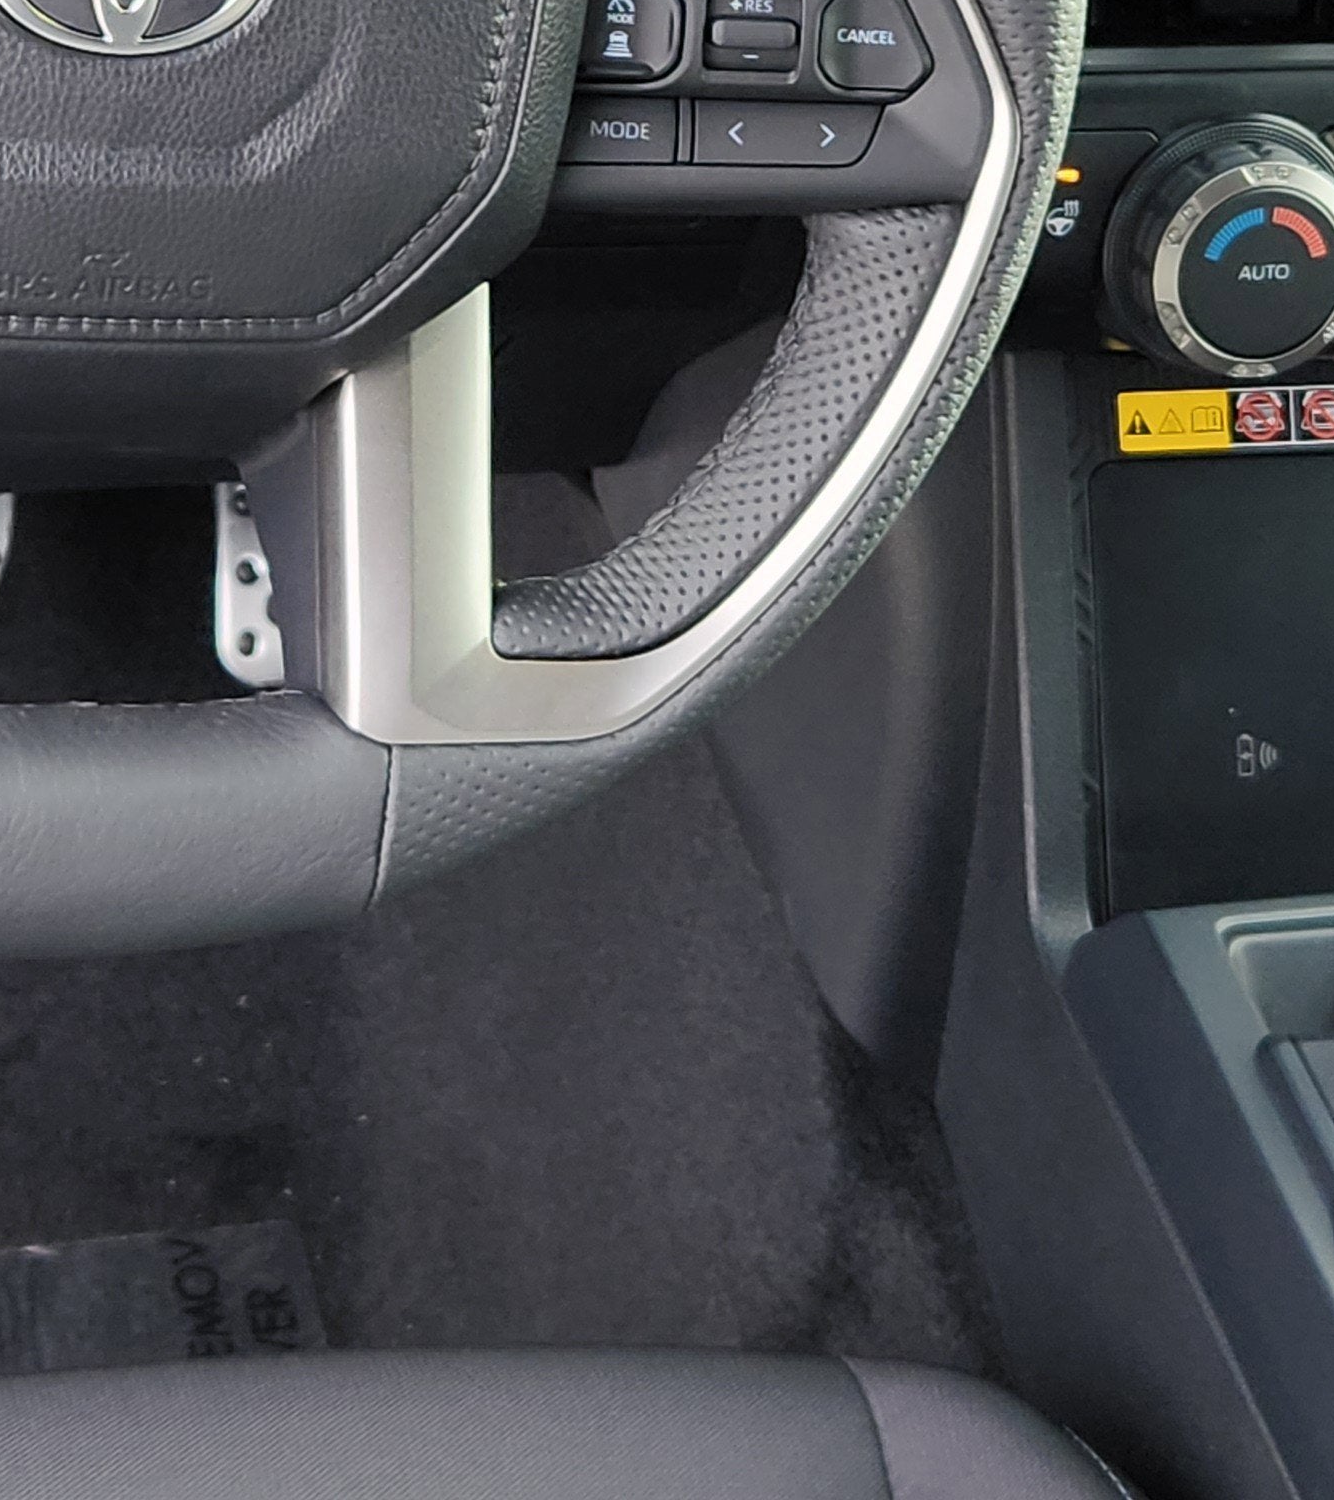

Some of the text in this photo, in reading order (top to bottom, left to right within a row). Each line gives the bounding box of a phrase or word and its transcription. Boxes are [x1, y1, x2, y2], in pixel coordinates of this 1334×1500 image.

[607, 14, 635, 25] MODE
[837, 28, 897, 46] CANCEL
[590, 120, 651, 140] MODE
[1238, 264, 1290, 282] AUTO
